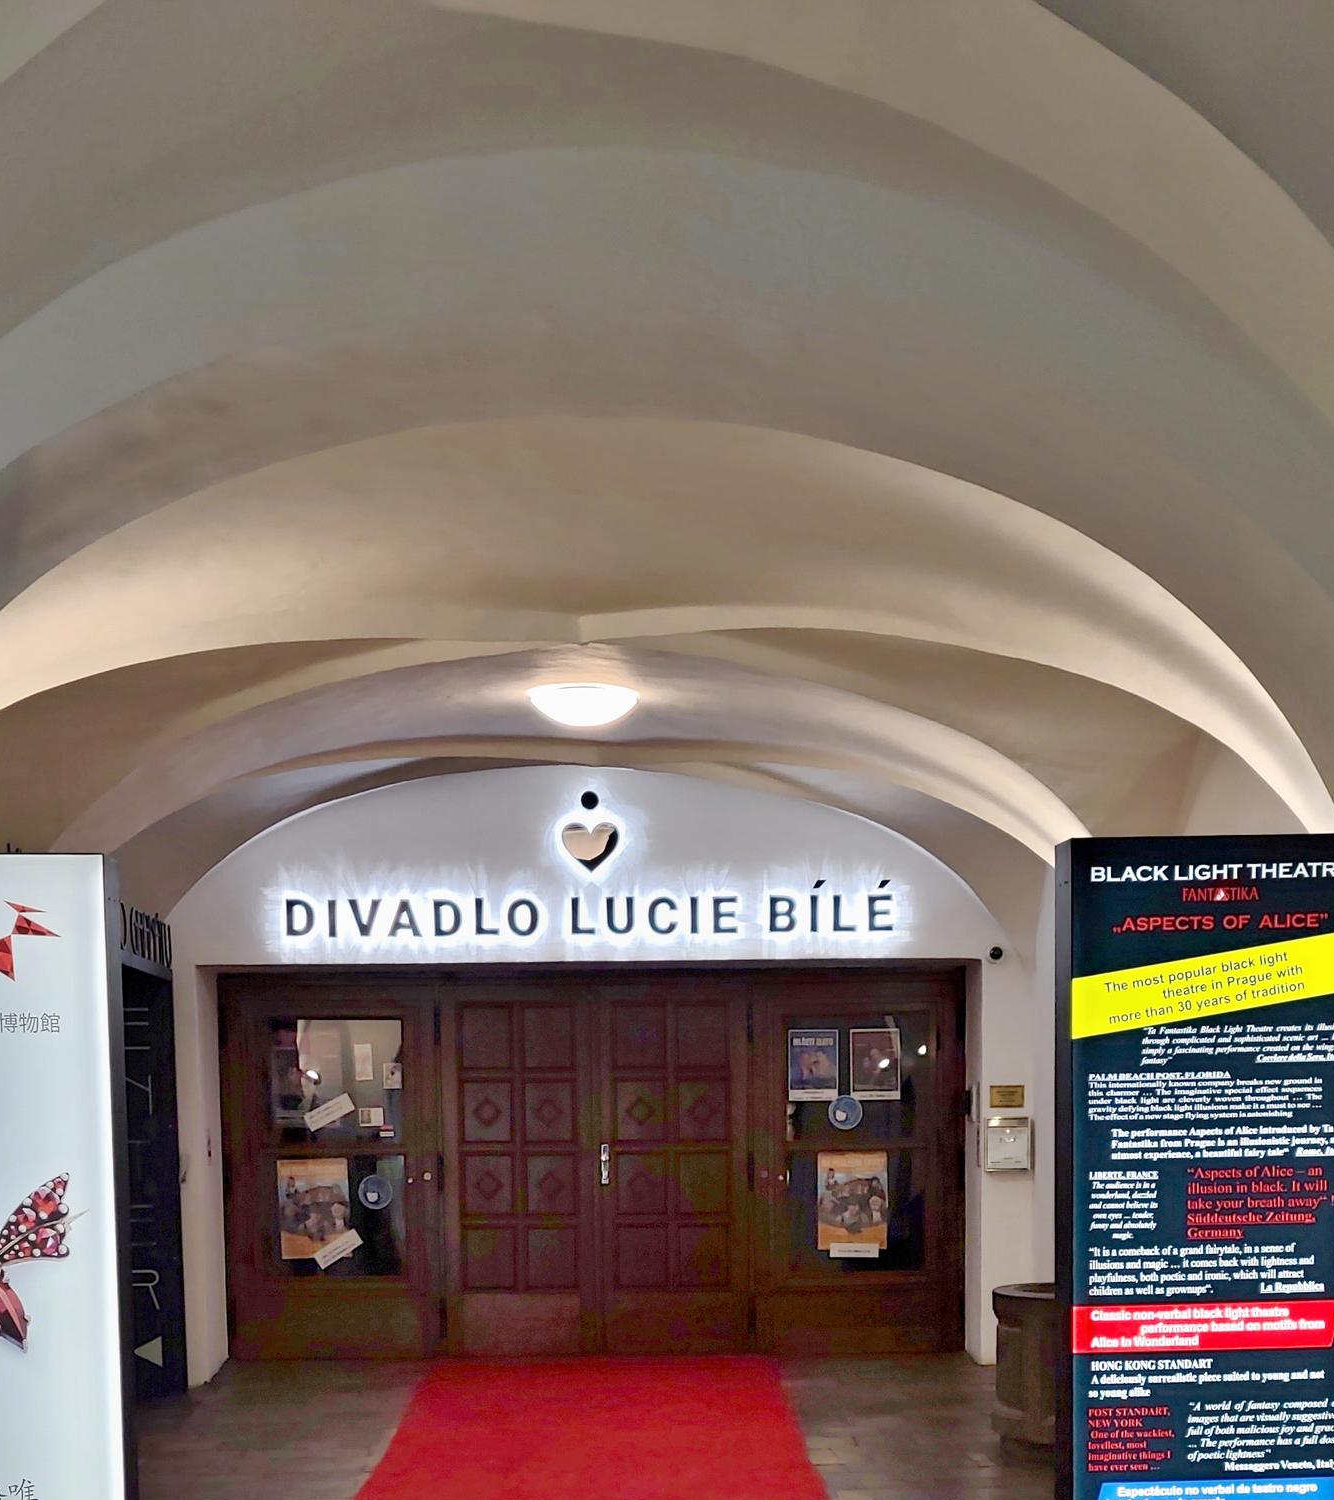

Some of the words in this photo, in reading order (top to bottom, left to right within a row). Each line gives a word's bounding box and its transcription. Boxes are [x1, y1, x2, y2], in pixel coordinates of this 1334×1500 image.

[1090, 865, 1168, 882] BLACK
[1174, 863, 1242, 880] LIGHT
[285, 897, 540, 938] DIVADLO
[571, 895, 739, 935] LUCIE
[769, 879, 894, 933] BÍLÉ
[1223, 915, 1250, 929] OF
[1105, 981, 1127, 992] The
[1132, 974, 1165, 988] most
[1168, 966, 1217, 984] popular
[1221, 957, 1254, 972] black
[1259, 952, 1288, 966] light
[1162, 983, 1207, 998] theatre
[1211, 979, 1222, 990] in
[1227, 972, 1271, 986] Prague
[1276, 965, 1302, 978] with
[1145, 1005, 1173, 1017] than
[1178, 999, 1192, 1012] 30
[1196, 995, 1230, 1011] years
[1235, 989, 1248, 1001] of
[1251, 982, 1304, 998] tradition
